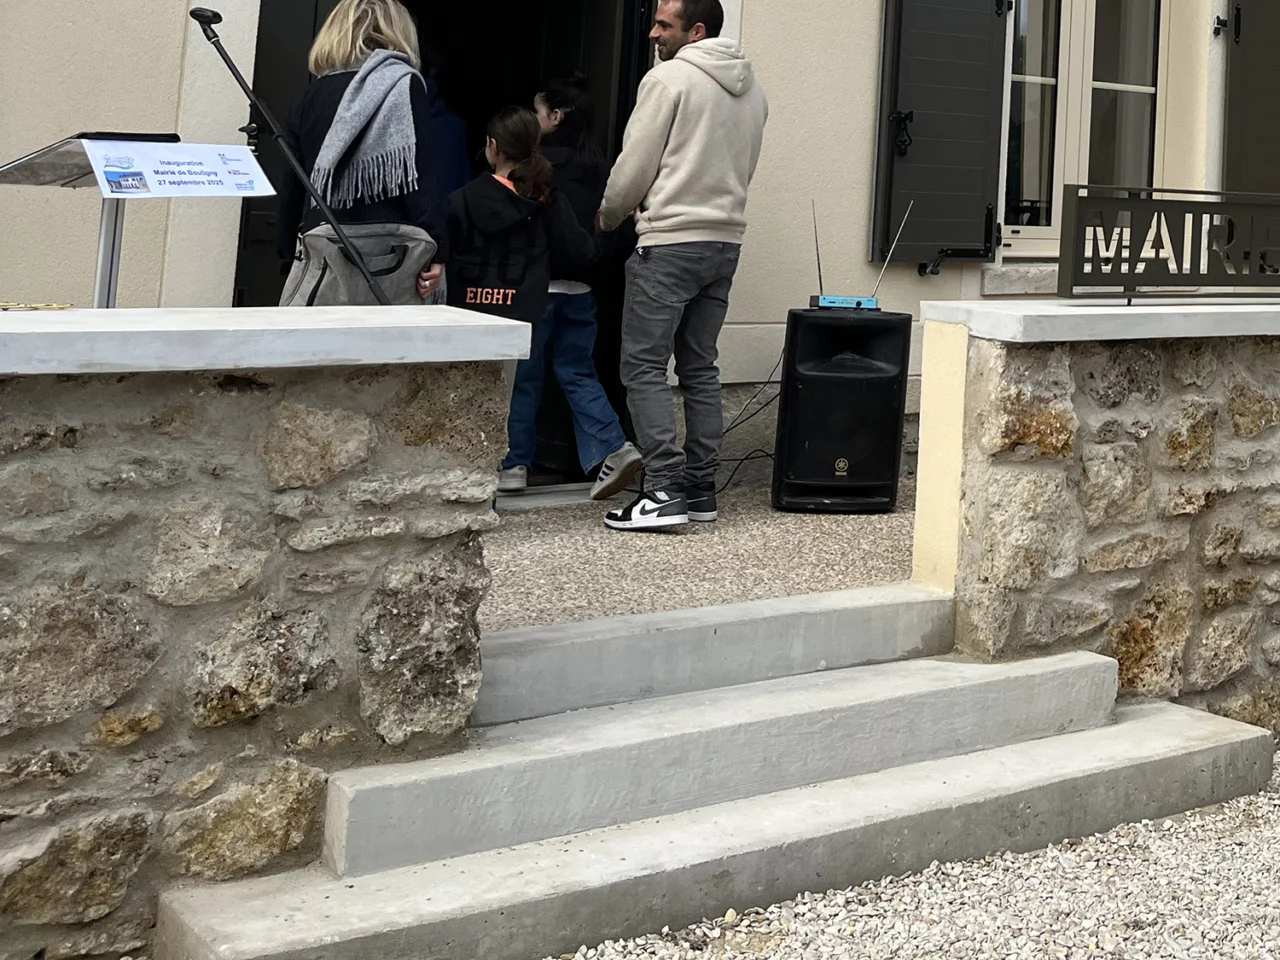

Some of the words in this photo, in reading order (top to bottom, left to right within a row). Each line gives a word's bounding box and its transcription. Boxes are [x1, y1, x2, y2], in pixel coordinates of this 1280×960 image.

[159, 159, 204, 167] Inauguration
[168, 179, 206, 187] septembre
[466, 287, 516, 305] EIGHT
